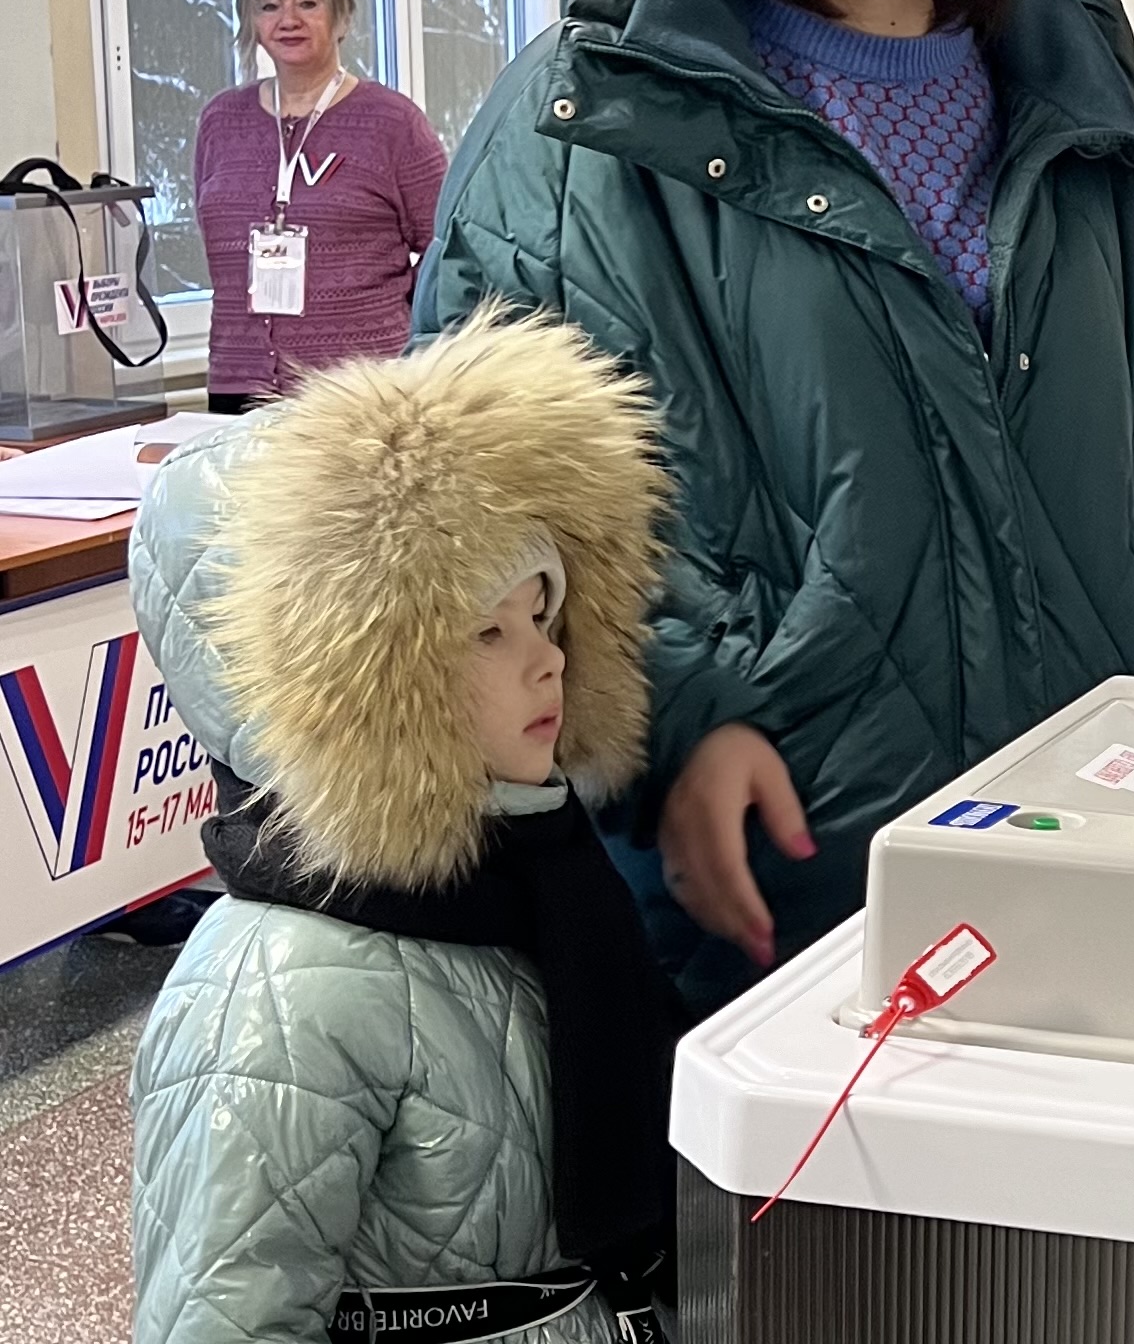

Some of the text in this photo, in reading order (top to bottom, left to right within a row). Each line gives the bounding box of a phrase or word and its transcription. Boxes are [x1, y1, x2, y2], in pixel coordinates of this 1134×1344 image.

[133, 733, 211, 794] РОСС
[183, 779, 217, 825] МА
[373, 1299, 488, 1332] FAVORITE
